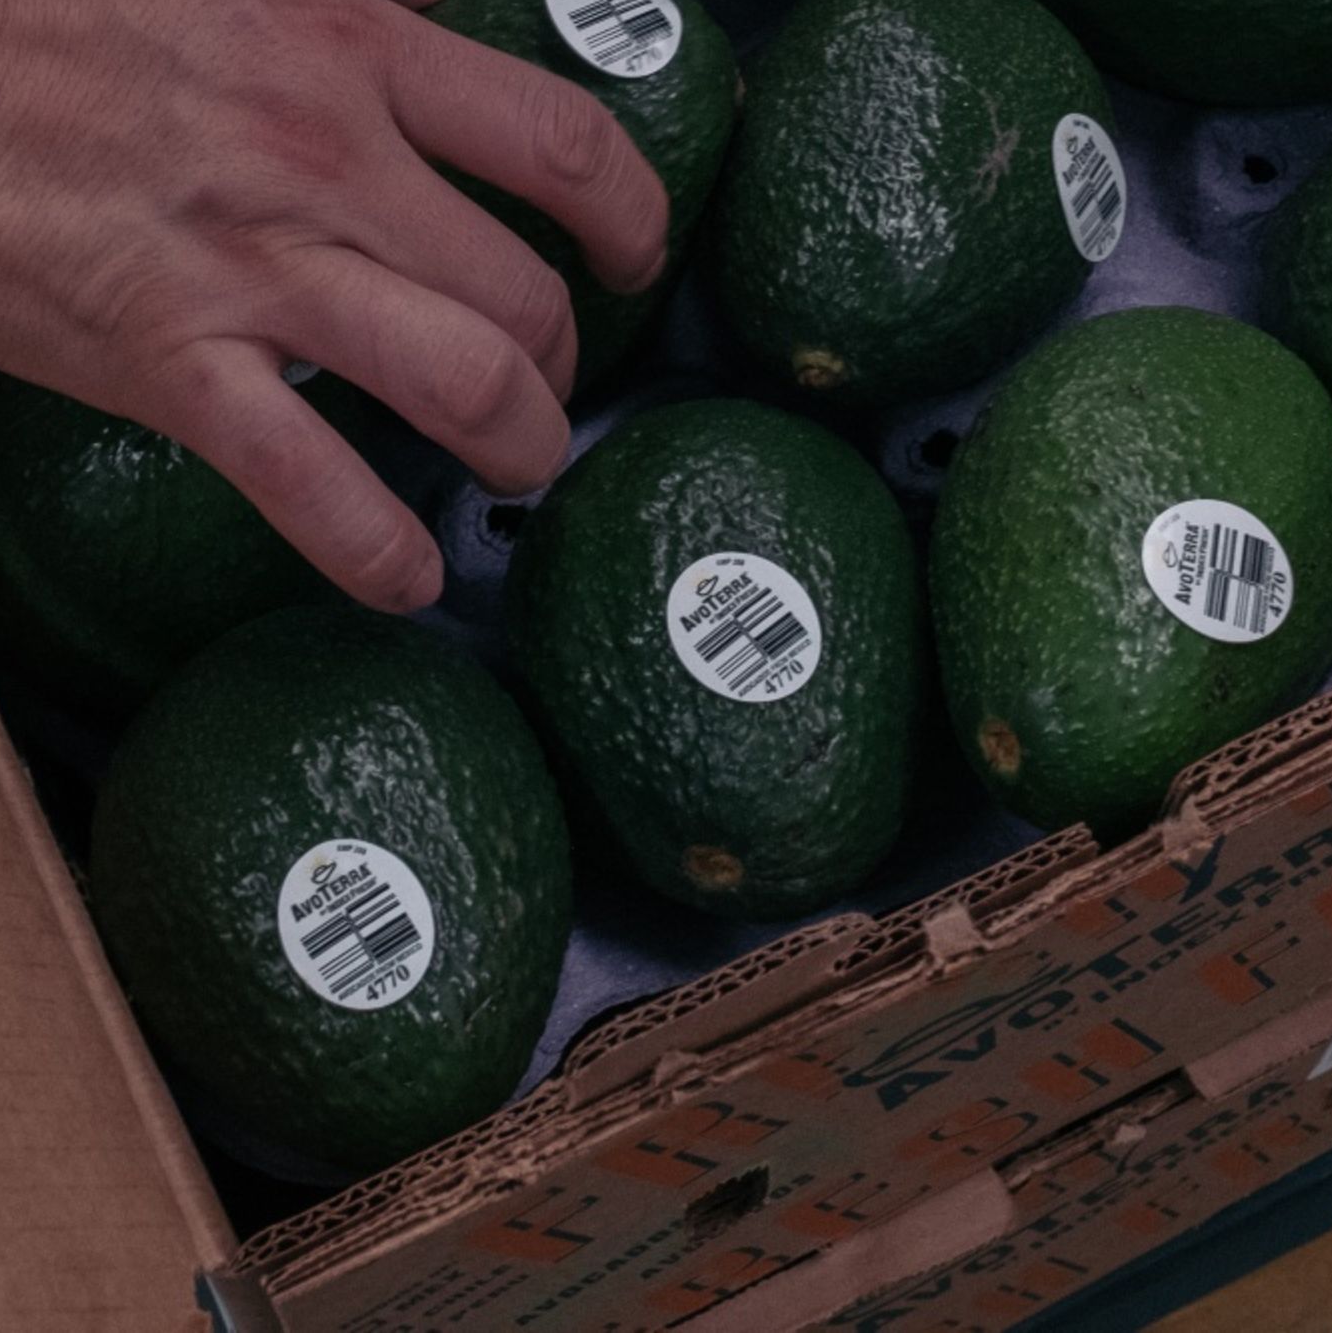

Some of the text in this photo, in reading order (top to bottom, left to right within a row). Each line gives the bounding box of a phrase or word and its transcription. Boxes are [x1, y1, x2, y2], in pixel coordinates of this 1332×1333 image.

[1174, 522, 1200, 604] AVOTERRA
[1268, 571, 1287, 617] 4770
[678, 570, 754, 632] AVOTERRA
[760, 657, 806, 697] 4770
[287, 860, 374, 922] AVOTERRA
[361, 962, 413, 1003] 4770
[1090, 909, 1248, 1002] INDEX
